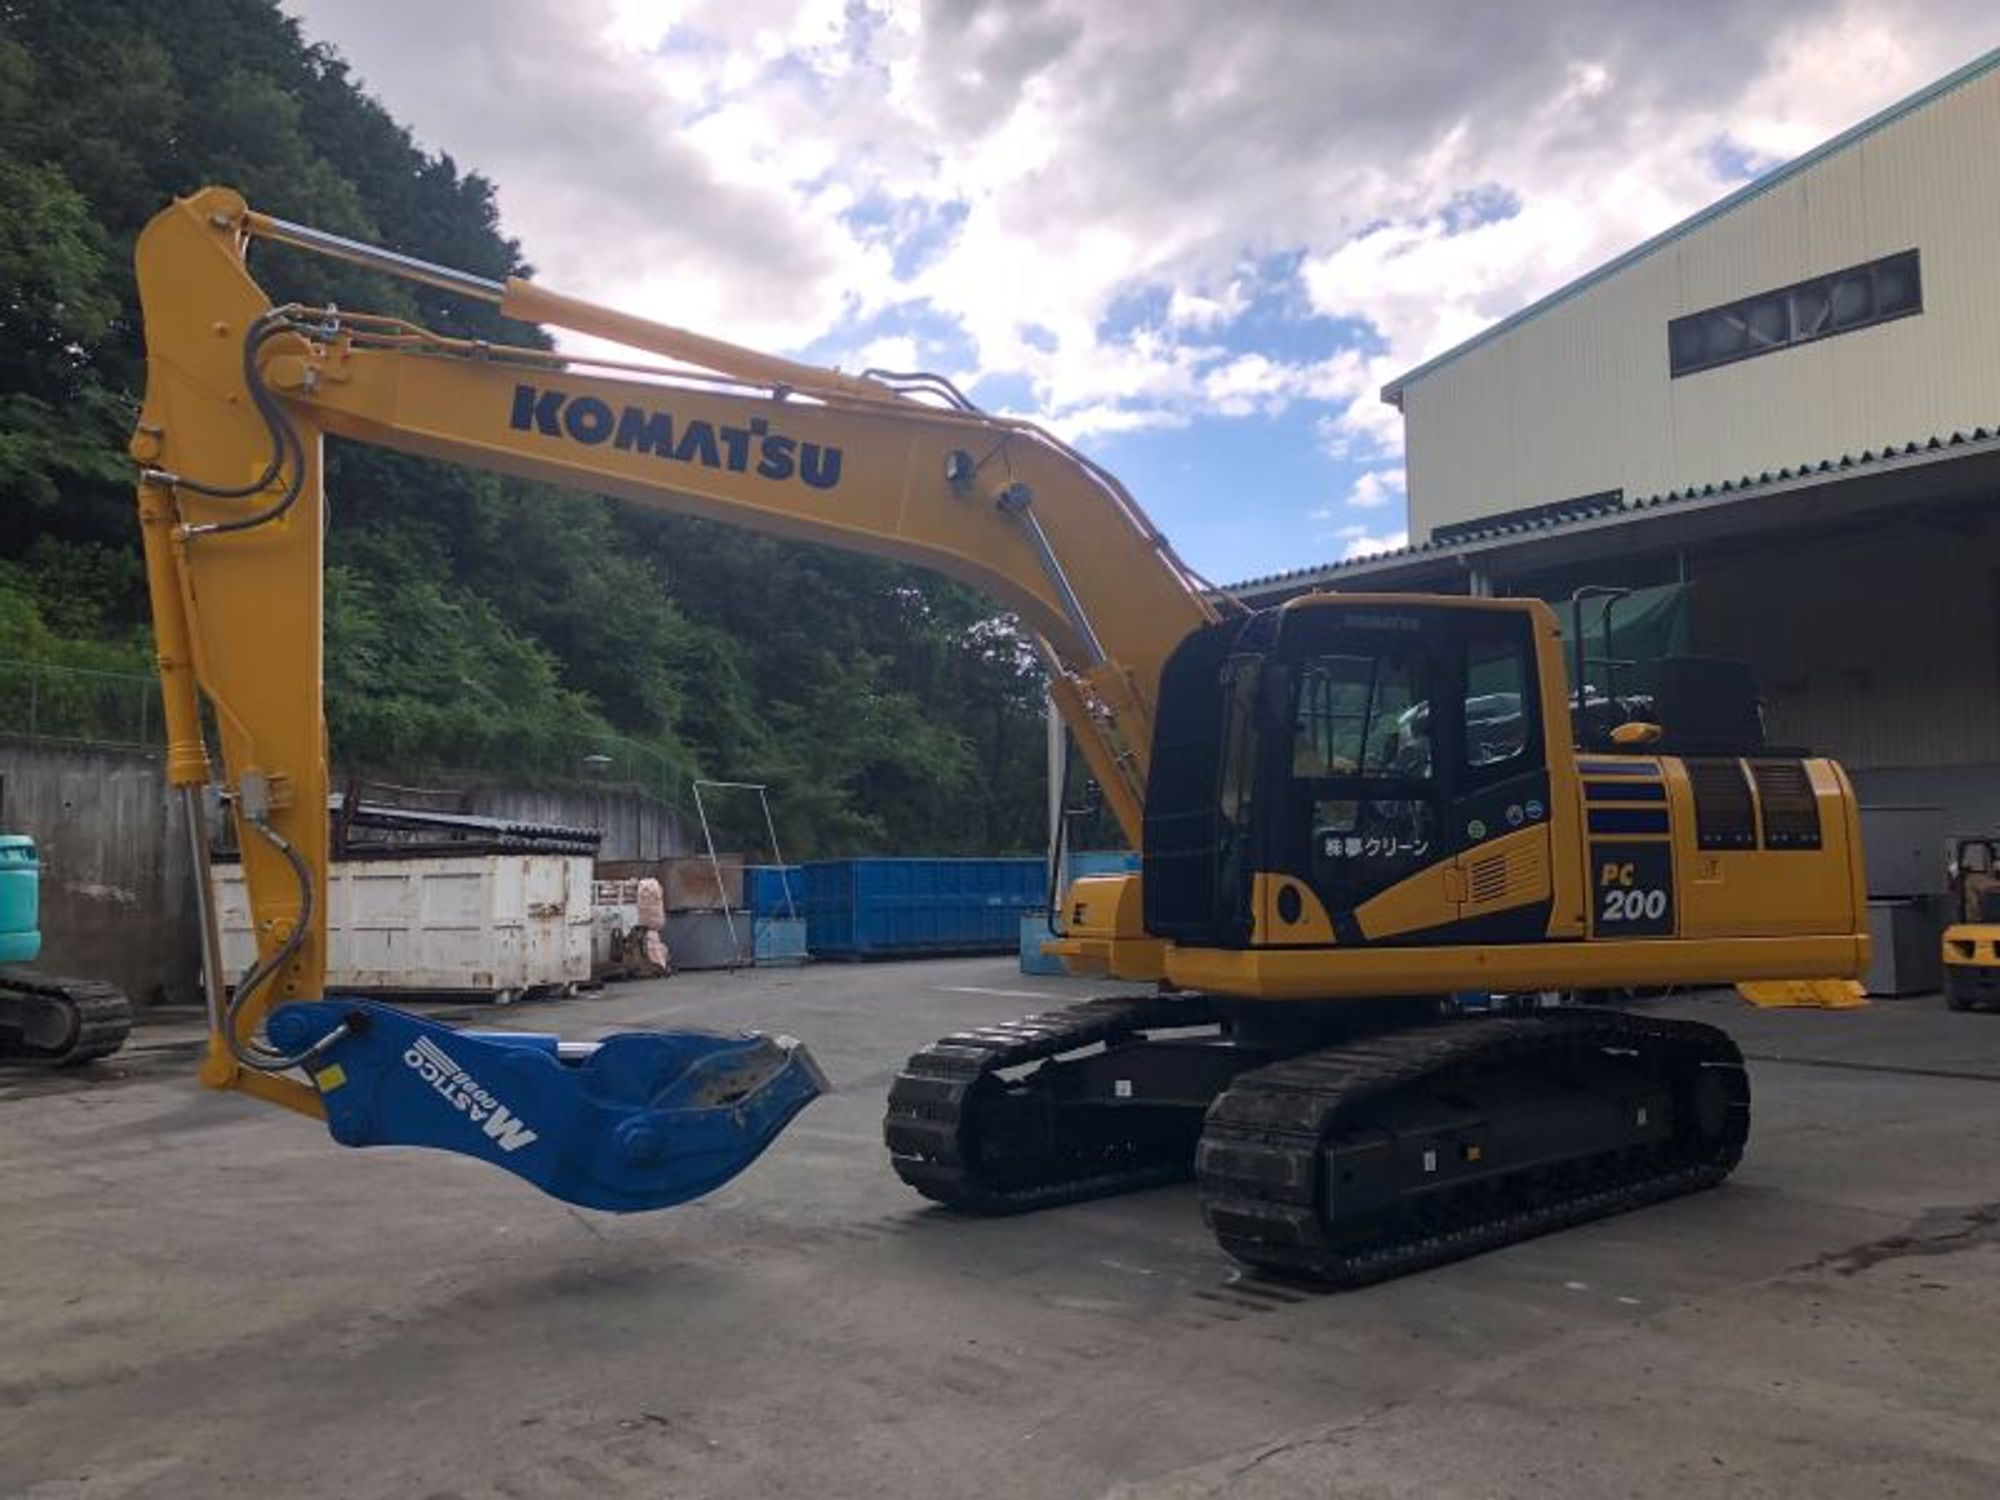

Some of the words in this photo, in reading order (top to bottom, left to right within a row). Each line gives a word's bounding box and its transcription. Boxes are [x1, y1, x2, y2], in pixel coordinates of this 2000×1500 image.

[510, 383, 843, 489] KOMATSU
[1600, 863, 1634, 886] PC
[1602, 890, 1667, 920] 200
[403, 1049, 538, 1151] MASTICO
